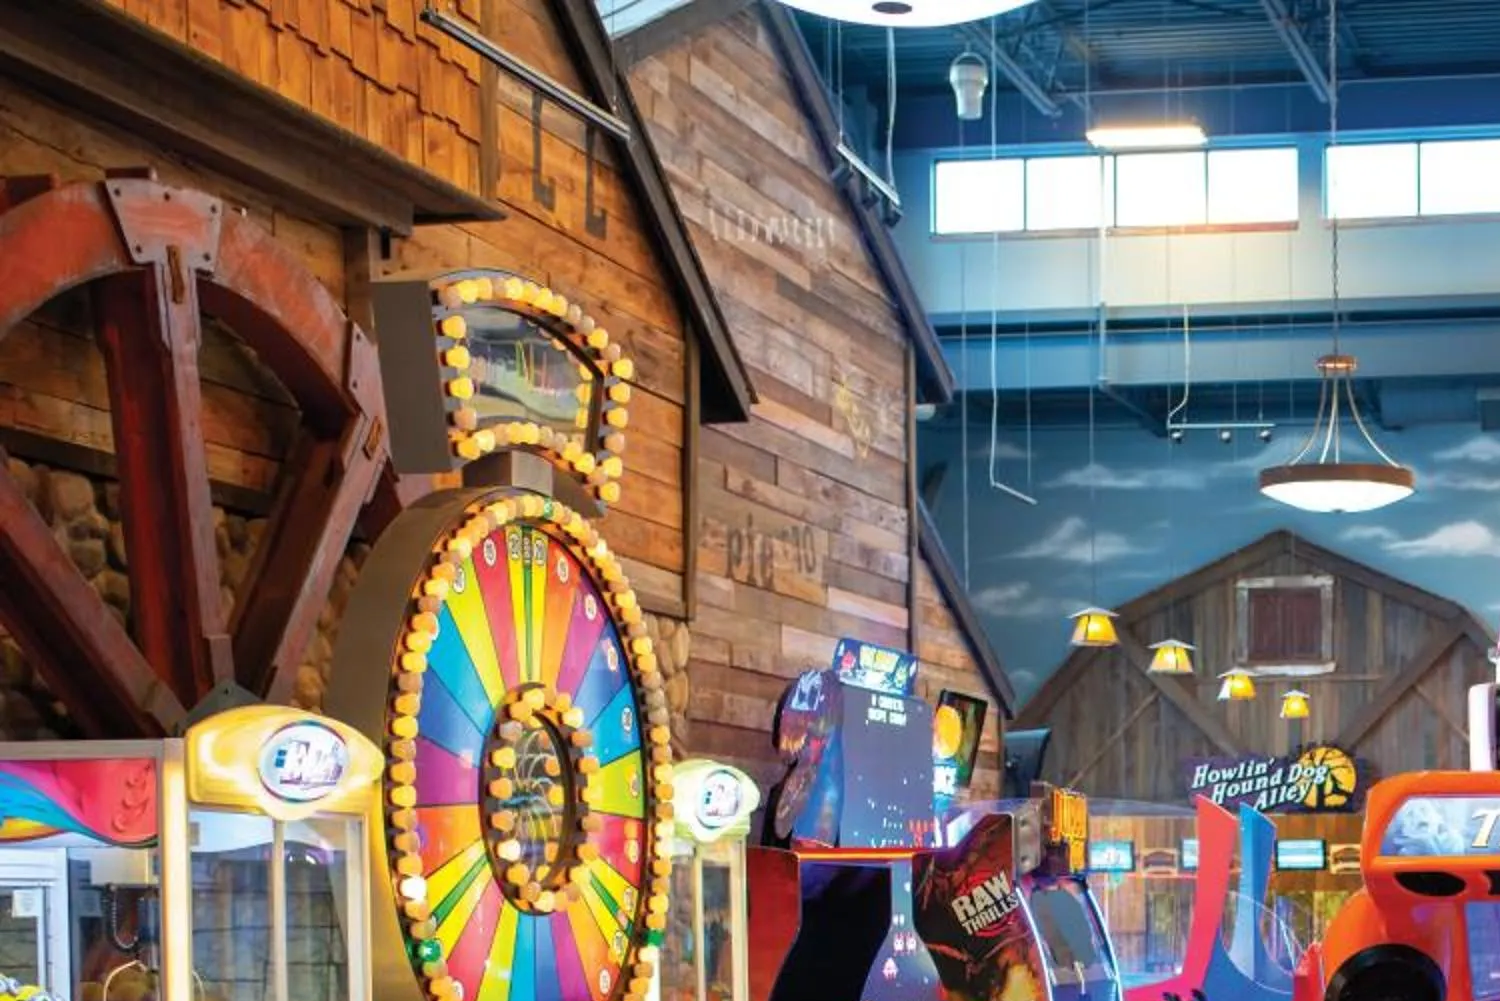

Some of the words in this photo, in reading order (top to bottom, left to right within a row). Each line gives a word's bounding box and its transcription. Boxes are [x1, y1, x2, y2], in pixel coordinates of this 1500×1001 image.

[1192, 757, 1275, 789] Howlin'
[1211, 768, 1282, 805] Hound
[1287, 762, 1328, 785] Dog
[1253, 780, 1312, 811] Alley
[952, 871, 1011, 921] RAW
[961, 891, 1019, 935] THRILLS
